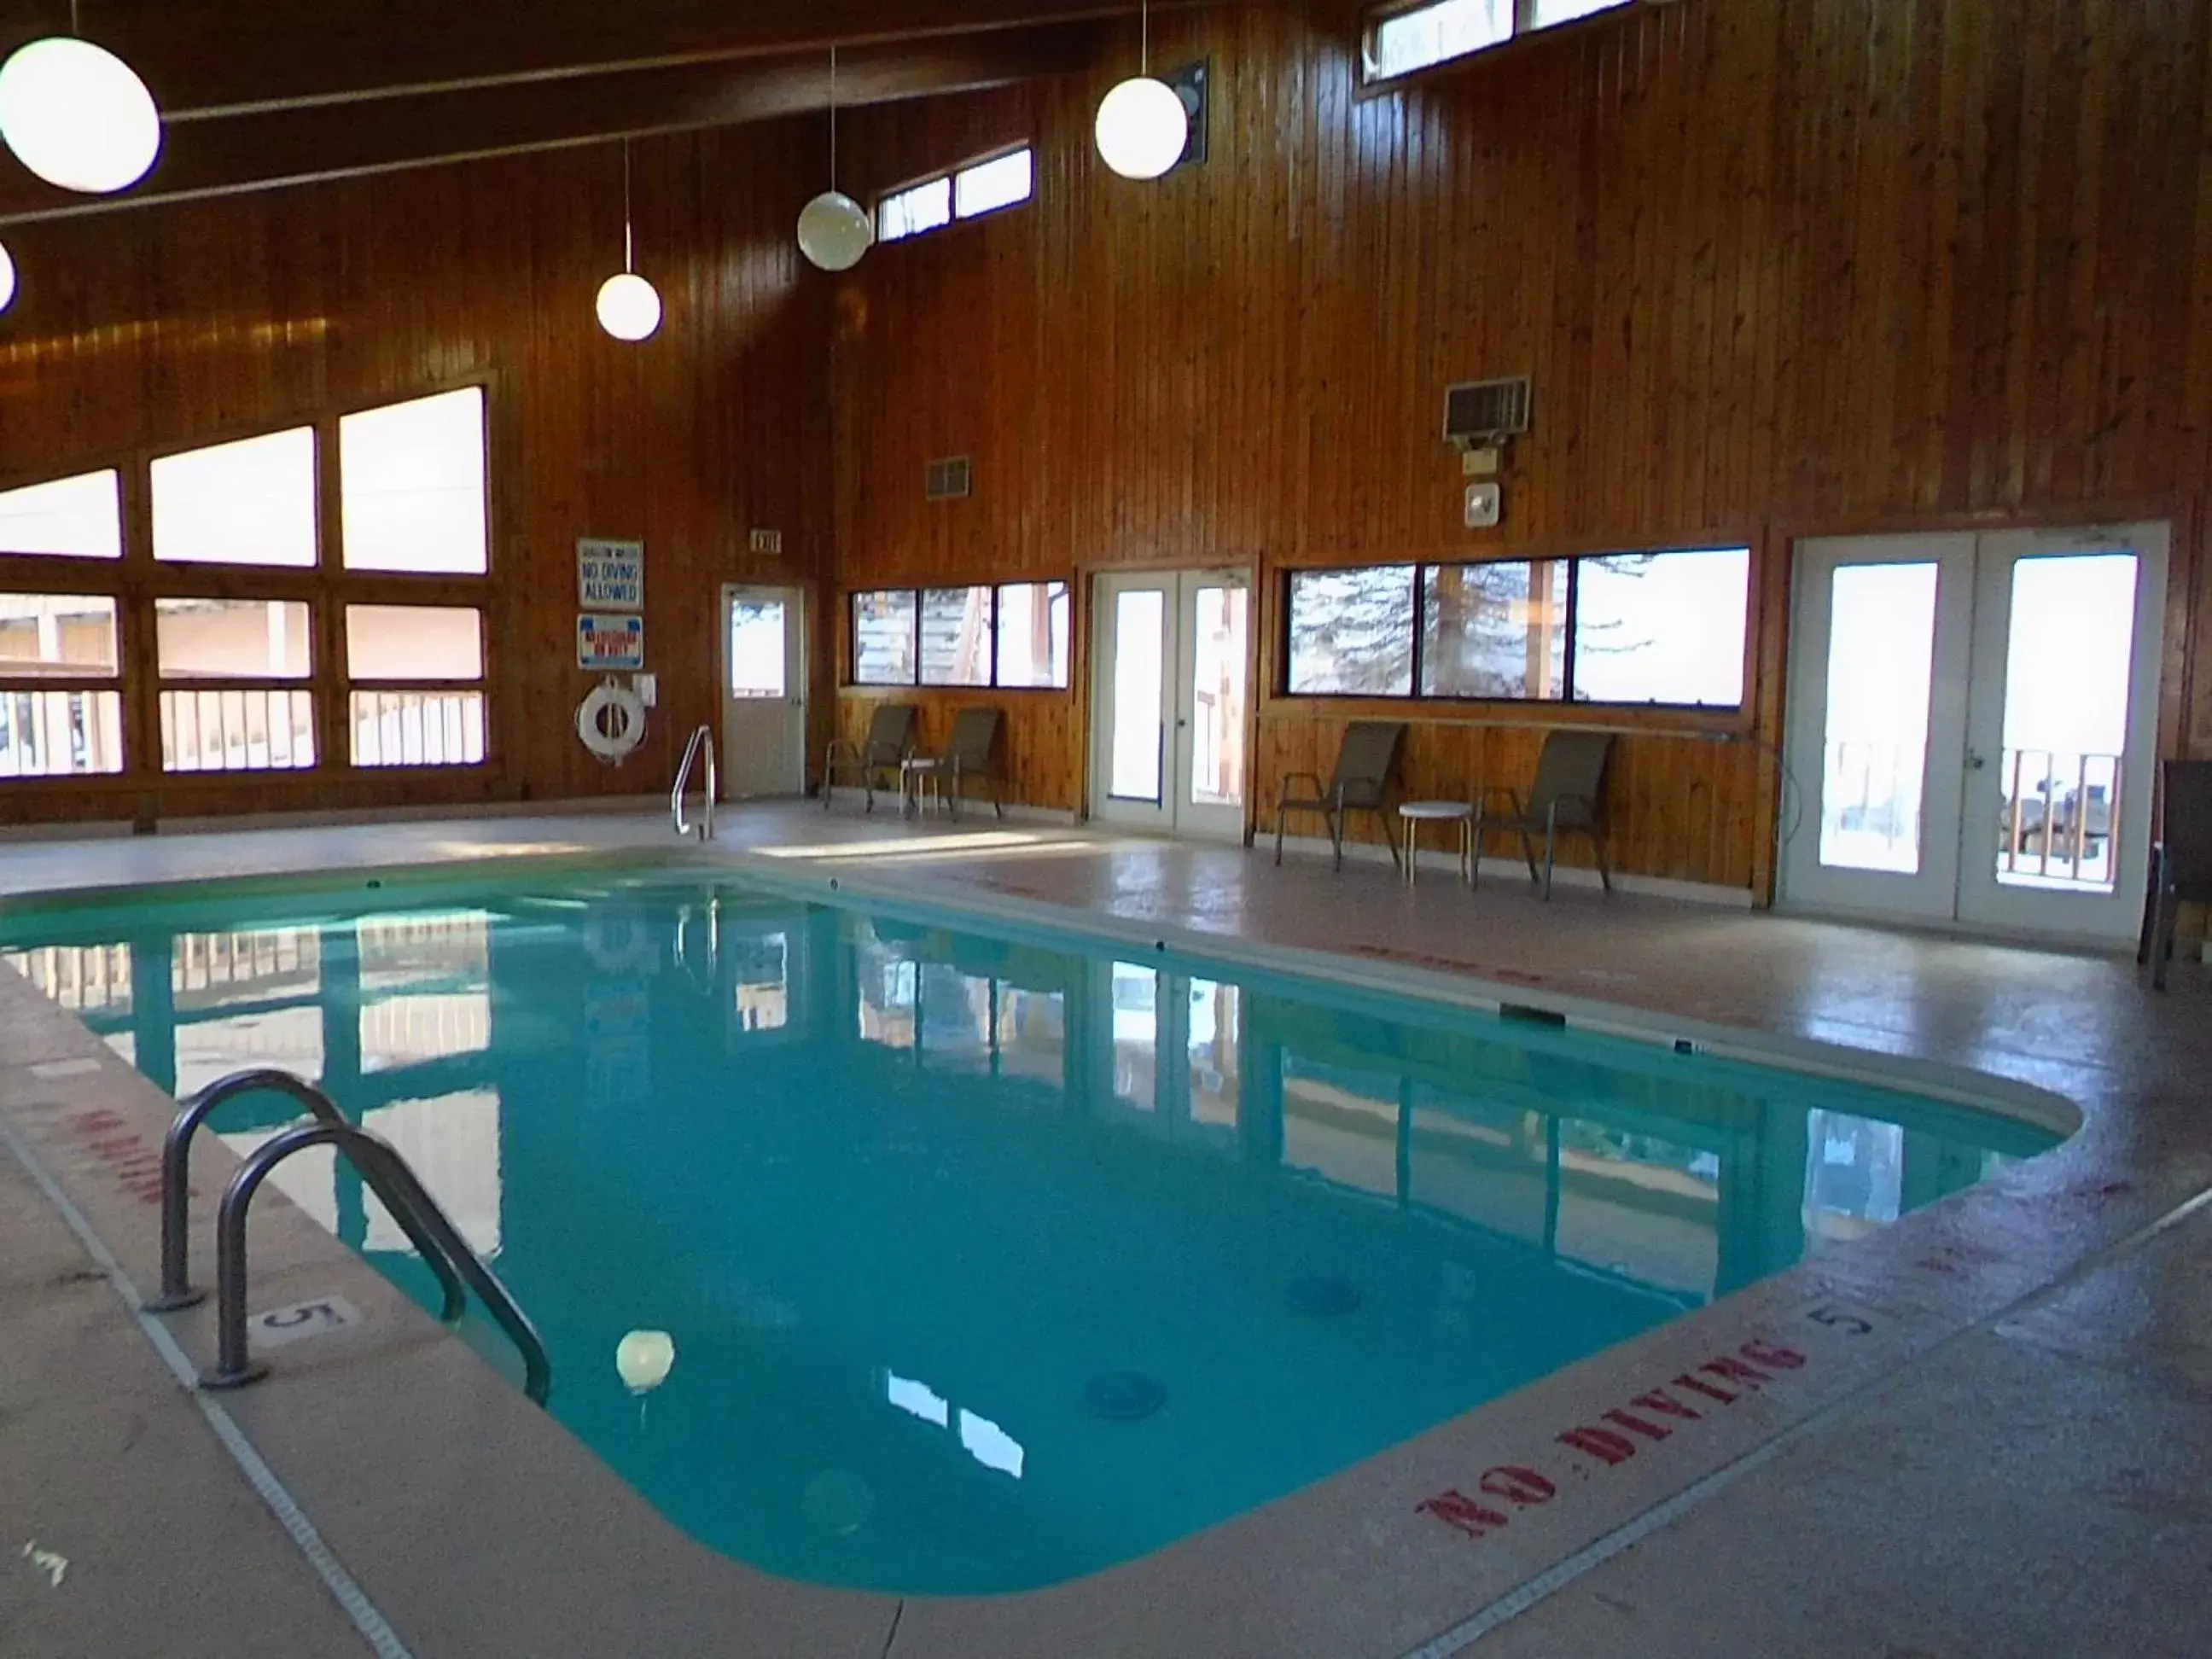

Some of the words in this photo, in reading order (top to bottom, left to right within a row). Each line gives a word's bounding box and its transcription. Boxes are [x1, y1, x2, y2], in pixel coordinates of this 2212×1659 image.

[583, 562, 597, 578] NO
[585, 582, 637, 601] ALLOWED
[1414, 1464, 1557, 1539] NO
[1554, 1339, 1807, 1466] DIVING
